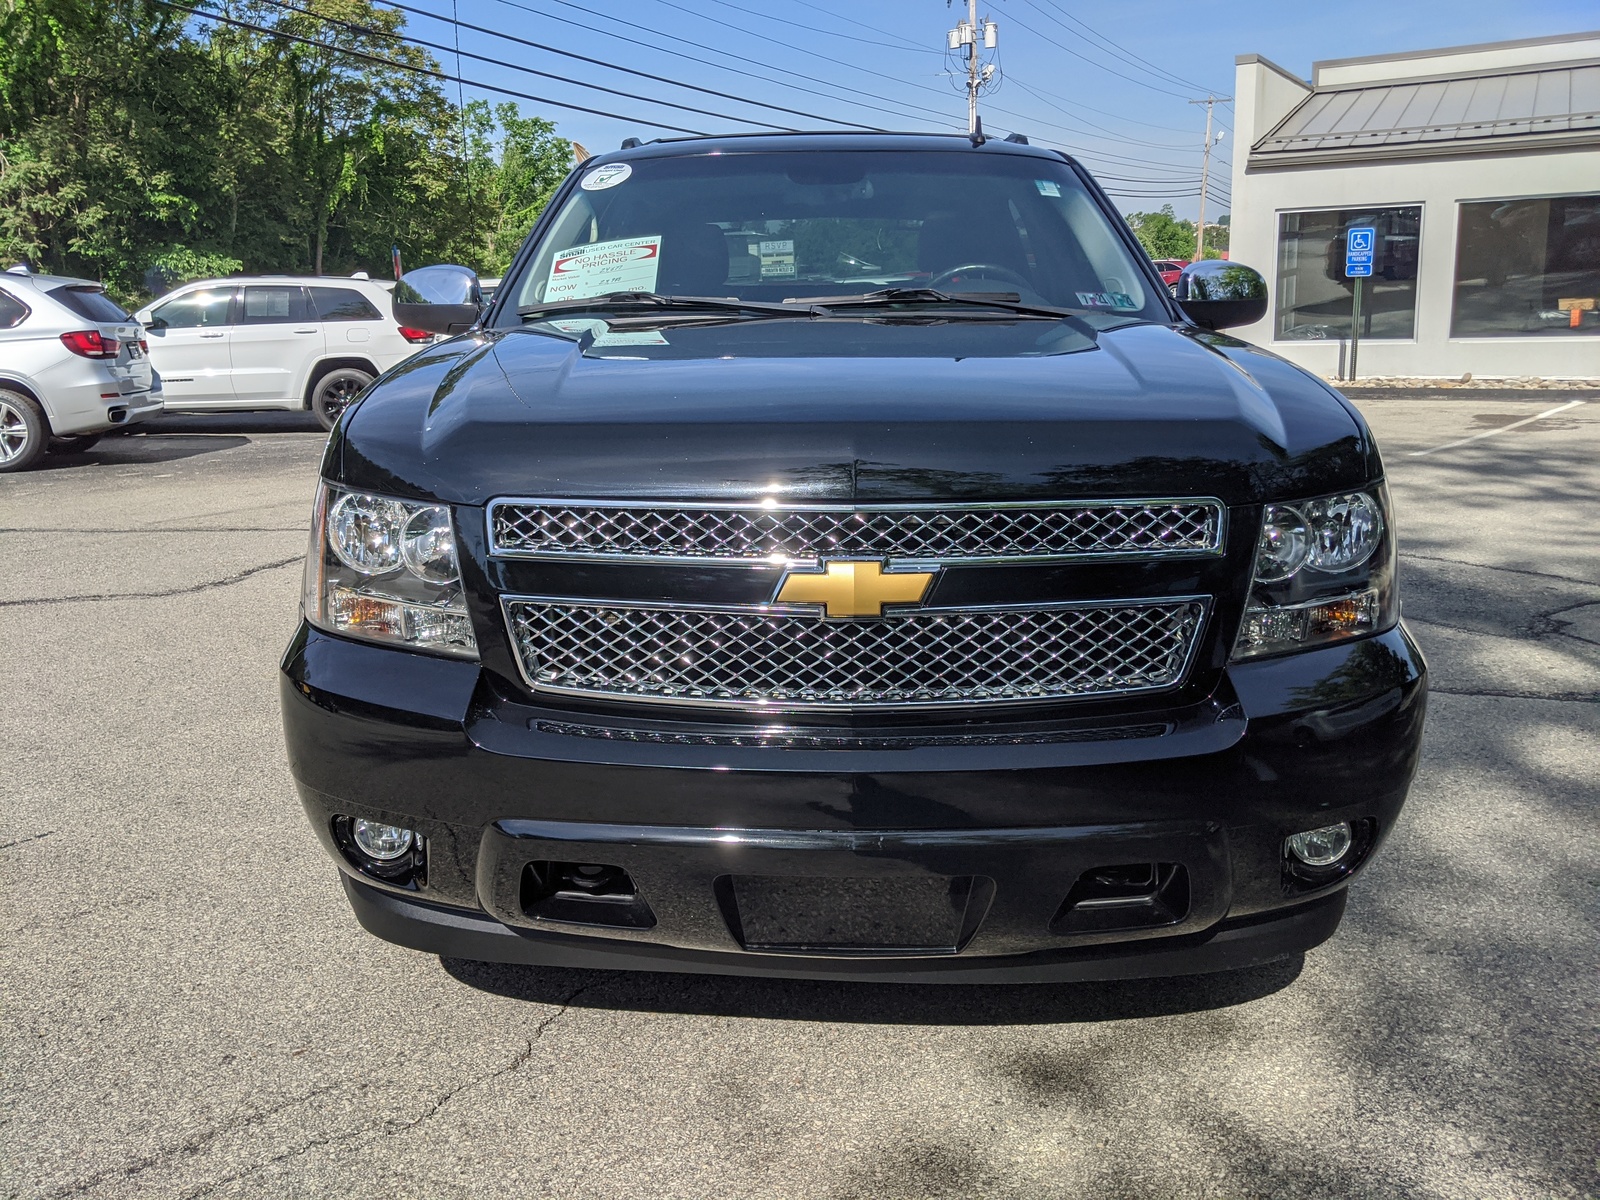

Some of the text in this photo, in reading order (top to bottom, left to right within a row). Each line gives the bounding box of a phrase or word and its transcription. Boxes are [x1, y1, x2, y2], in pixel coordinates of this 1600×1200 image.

[585, 246, 606, 254] USED
[765, 241, 787, 250] RSVP
[574, 249, 637, 266] NO HASSLE
[581, 258, 628, 269] PRICING
[549, 284, 577, 293] NOW
